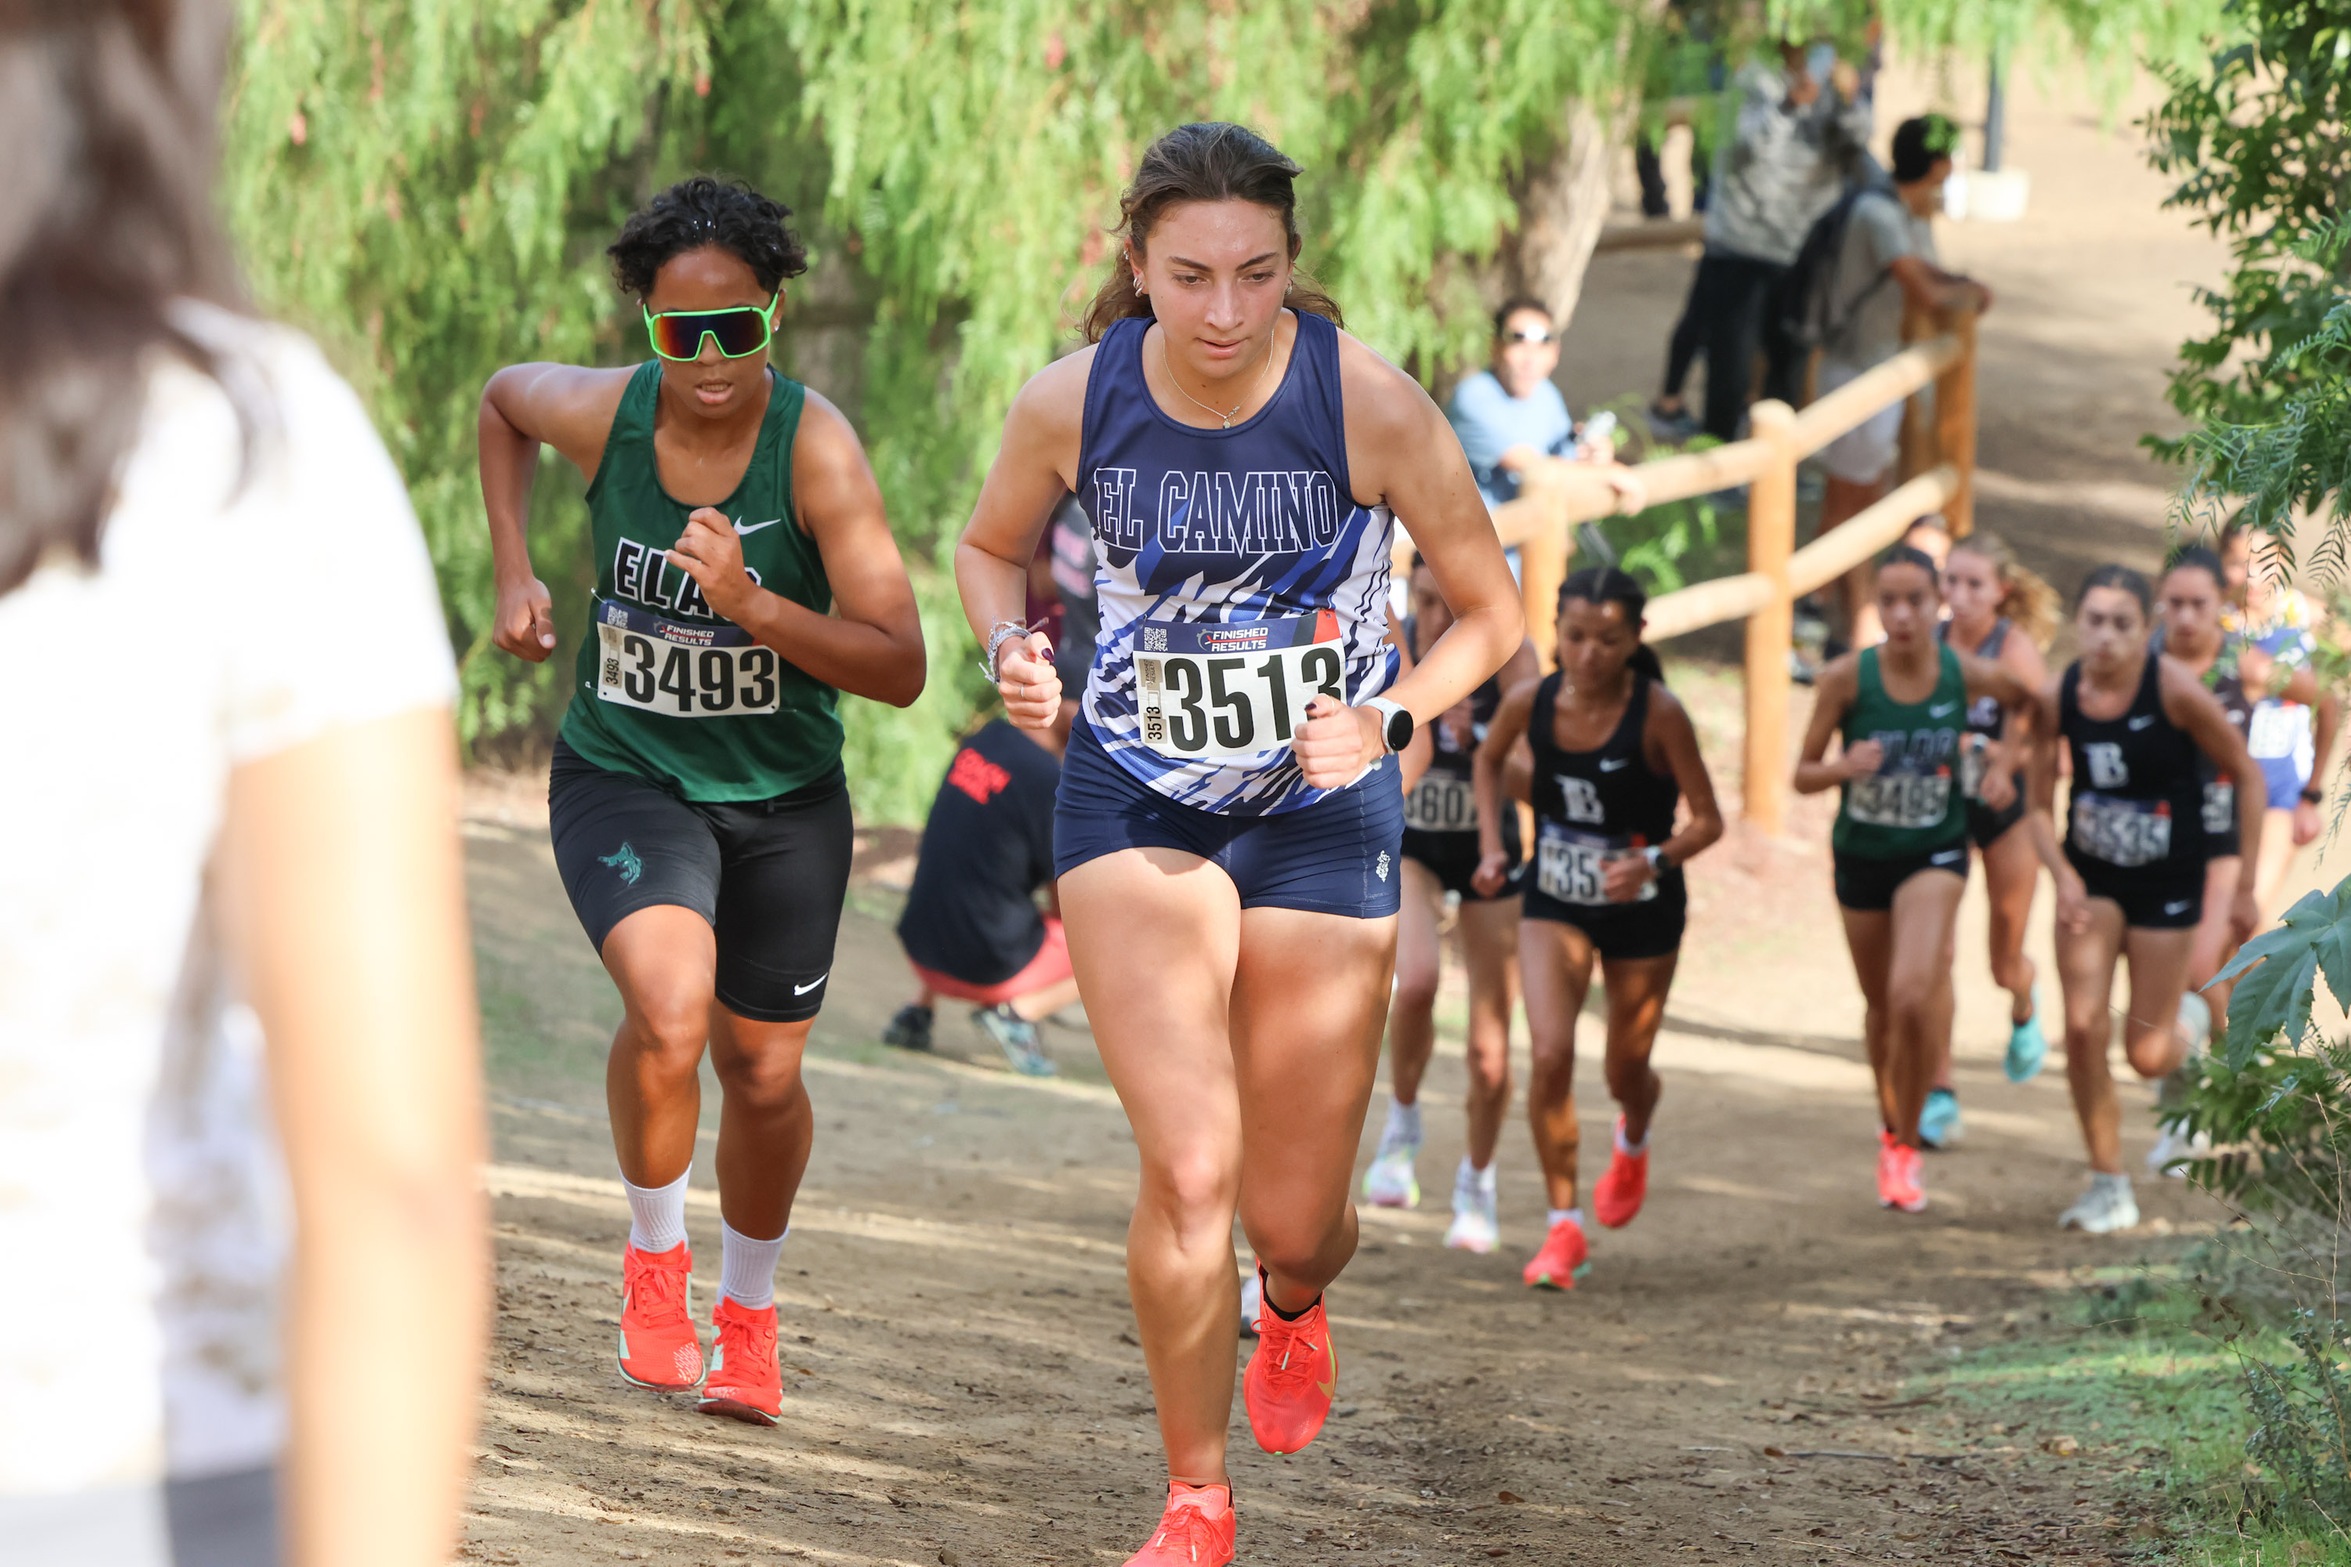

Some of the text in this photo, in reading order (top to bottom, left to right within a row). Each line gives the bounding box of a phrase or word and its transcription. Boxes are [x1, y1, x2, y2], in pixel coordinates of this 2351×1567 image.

[1094, 467, 1144, 552] EL
[1157, 470, 1339, 559] CAMINO
[614, 536, 762, 622] ELA
[664, 632, 713, 646] RESULTS
[666, 624, 715, 638] FINISHED
[1211, 639, 1267, 652] RESULTS
[1213, 627, 1268, 640] FINISHED
[605, 657, 619, 685] 3493
[623, 634, 774, 712] 3493
[1146, 706, 1162, 740] 3513
[2082, 742, 2129, 789] B
[1554, 774, 1604, 825] B
